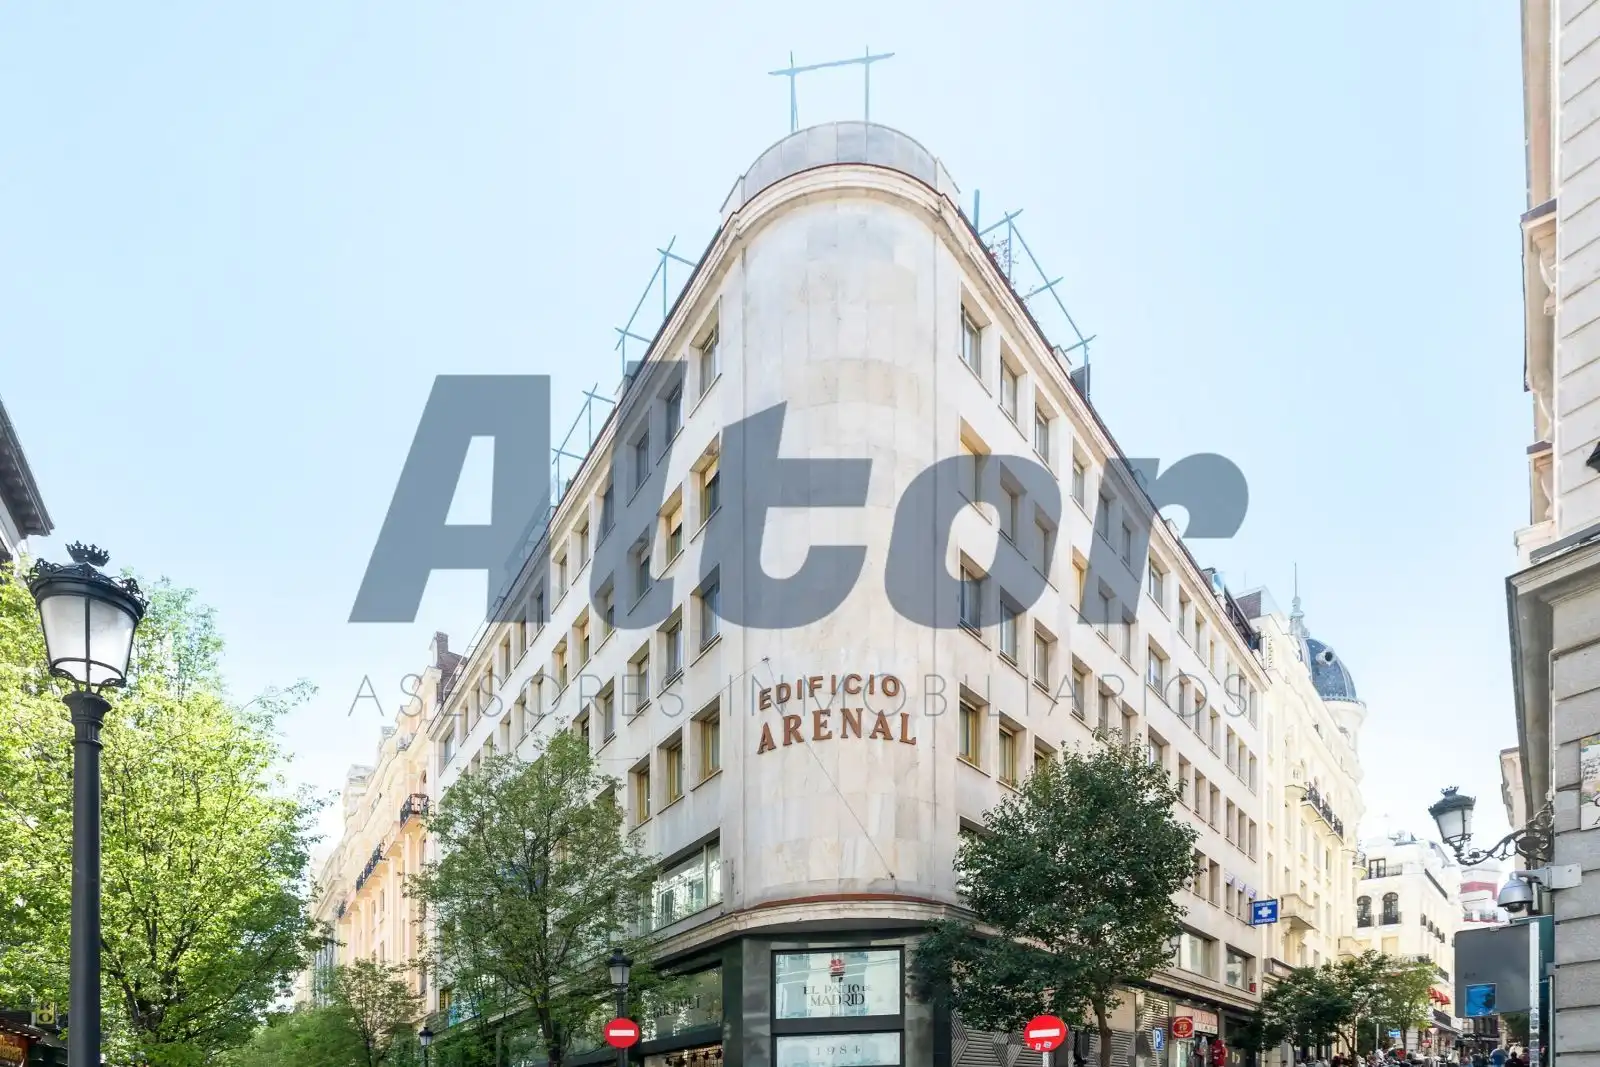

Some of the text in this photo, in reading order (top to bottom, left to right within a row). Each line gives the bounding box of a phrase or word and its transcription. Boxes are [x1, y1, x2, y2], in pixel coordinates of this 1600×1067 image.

[759, 674, 901, 711] EDIFICIO
[757, 708, 917, 754] ARENAL
[803, 984, 820, 995] EL
[824, 983, 861, 995] PATIO
[810, 993, 865, 1007] MADRID
